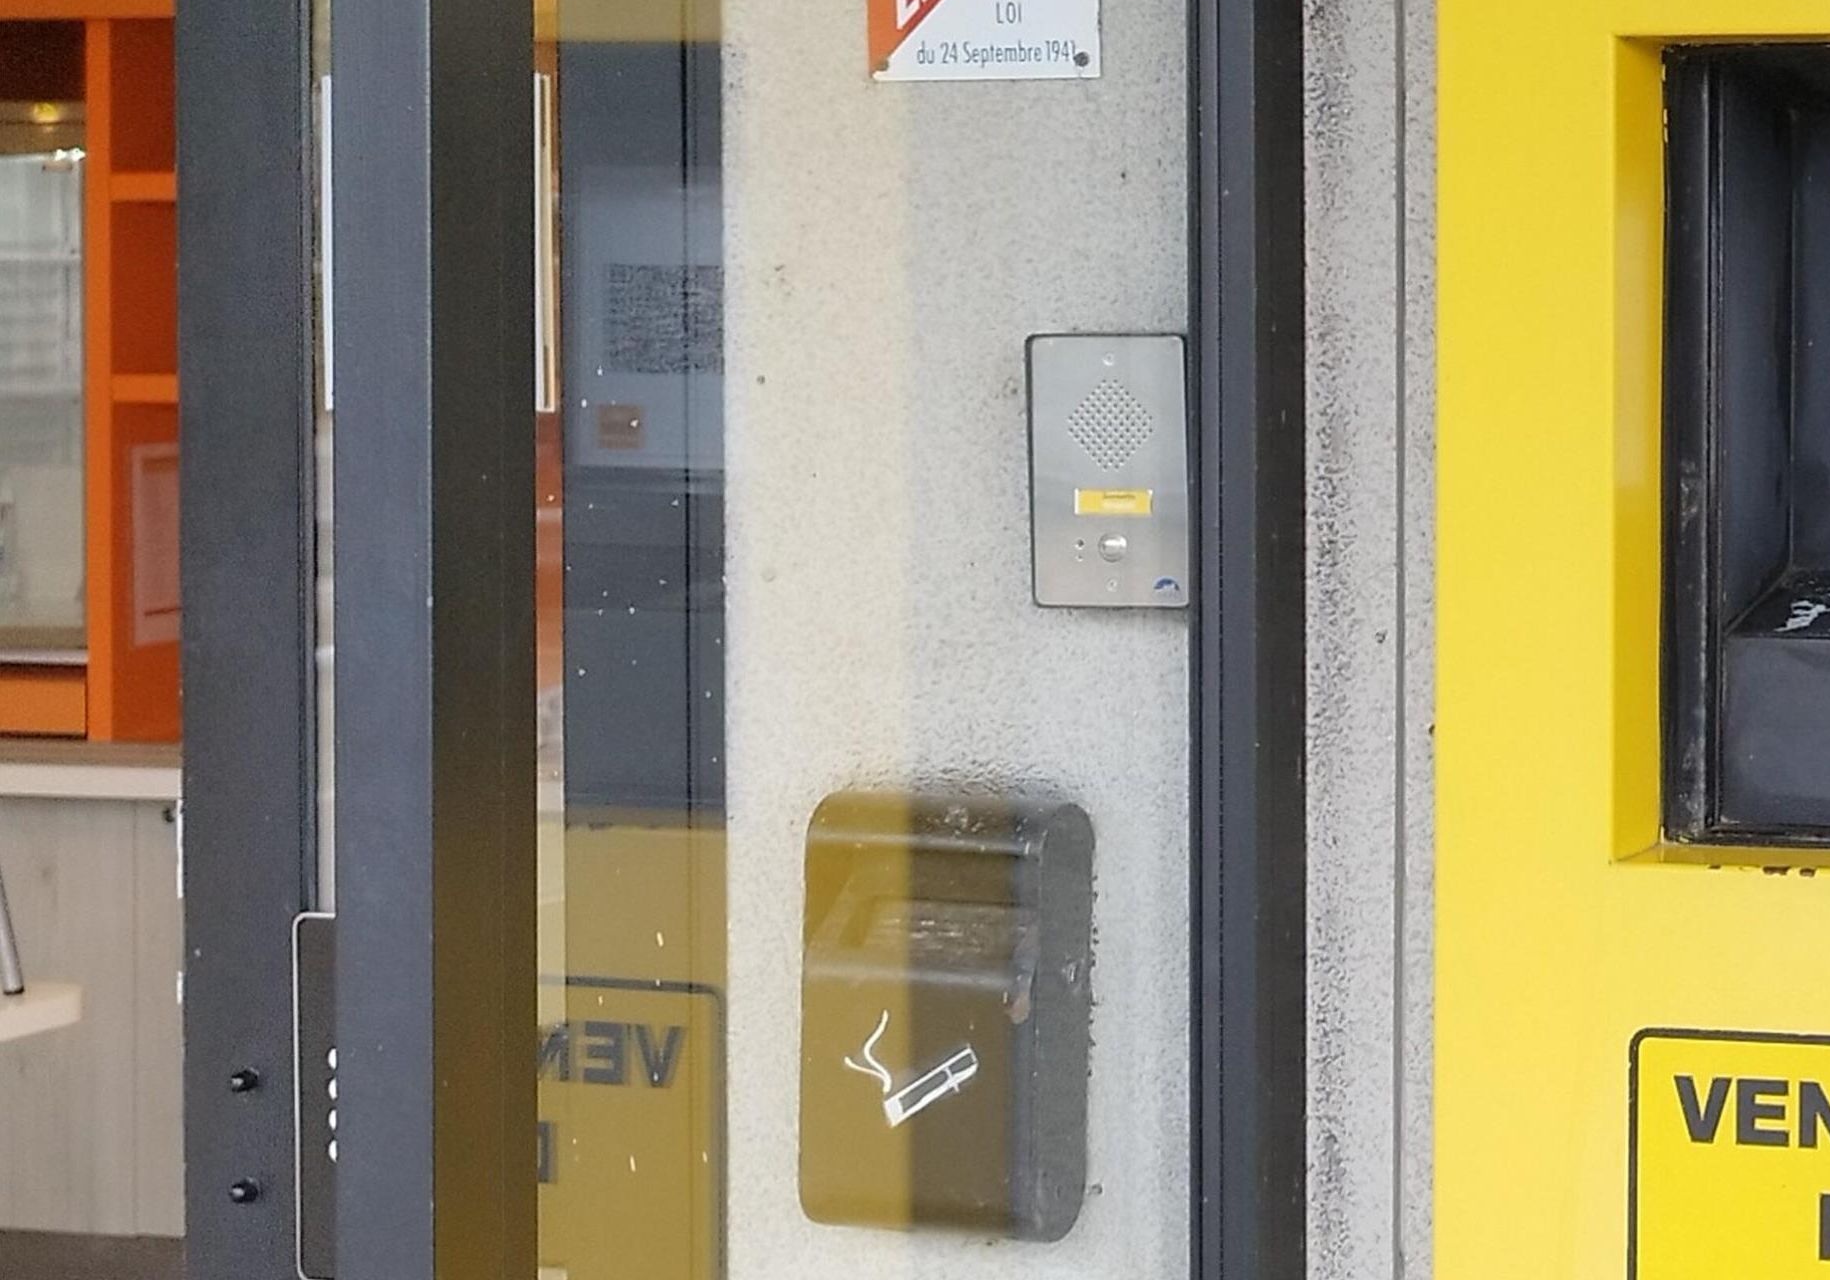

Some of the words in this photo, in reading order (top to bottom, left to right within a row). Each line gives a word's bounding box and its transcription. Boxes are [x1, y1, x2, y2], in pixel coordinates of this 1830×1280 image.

[916, 41, 935, 65] du
[940, 41, 958, 64] 24
[963, 40, 1042, 68] Septembre
[1045, 38, 1076, 63] 1941
